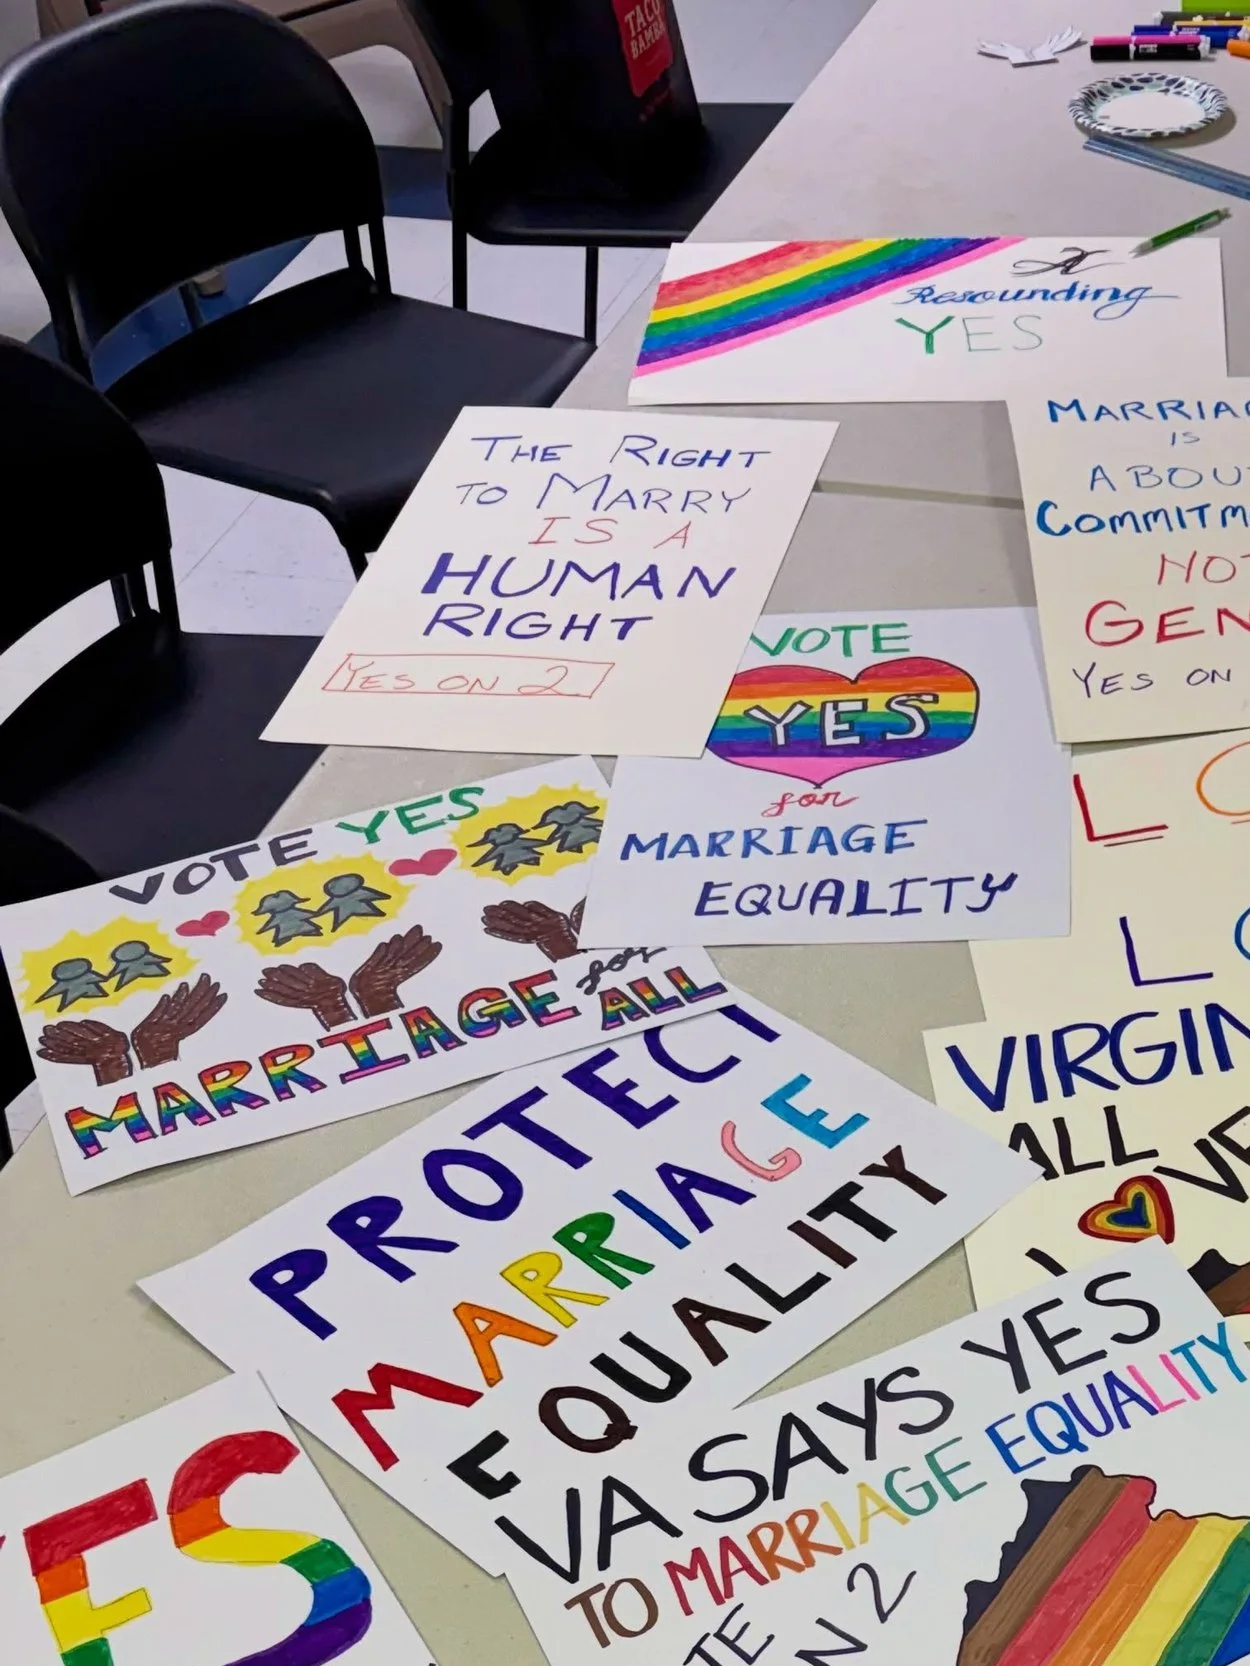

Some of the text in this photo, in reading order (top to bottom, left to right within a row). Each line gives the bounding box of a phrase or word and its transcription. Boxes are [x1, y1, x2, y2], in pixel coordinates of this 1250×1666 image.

[892, 281, 1181, 321] Resounding
[894, 314, 1043, 354] YES
[471, 435, 771, 468] THE RIGHT
[1170, 431, 1200, 446] IS
[456, 472, 752, 514] TO MARRY
[528, 516, 692, 549] IS A
[421, 553, 737, 600] HUMAN
[423, 603, 653, 641] RIGHT
[750, 622, 913, 657] VOTE
[340, 661, 577, 696] YES ON 2
[1072, 661, 1153, 699] YES
[1186, 668, 1231, 686] ON
[744, 693, 939, 748] YES
[761, 790, 859, 817] for
[109, 786, 486, 906] VOTE YES
[620, 819, 928, 861] MARRIAGE
[694, 872, 1018, 917] EQUALITY
[63, 947, 728, 1160] MARRIAGE for ALL
[1008, 1105, 1159, 1181] ALL
[331, 1072, 870, 1472] MARRIAGE
[494, 1270, 1161, 1584] VA SAYS YES
[564, 1320, 1247, 1649] TO MARRIAGE EQUALITY
[847, 1562, 917, 1623] 2
